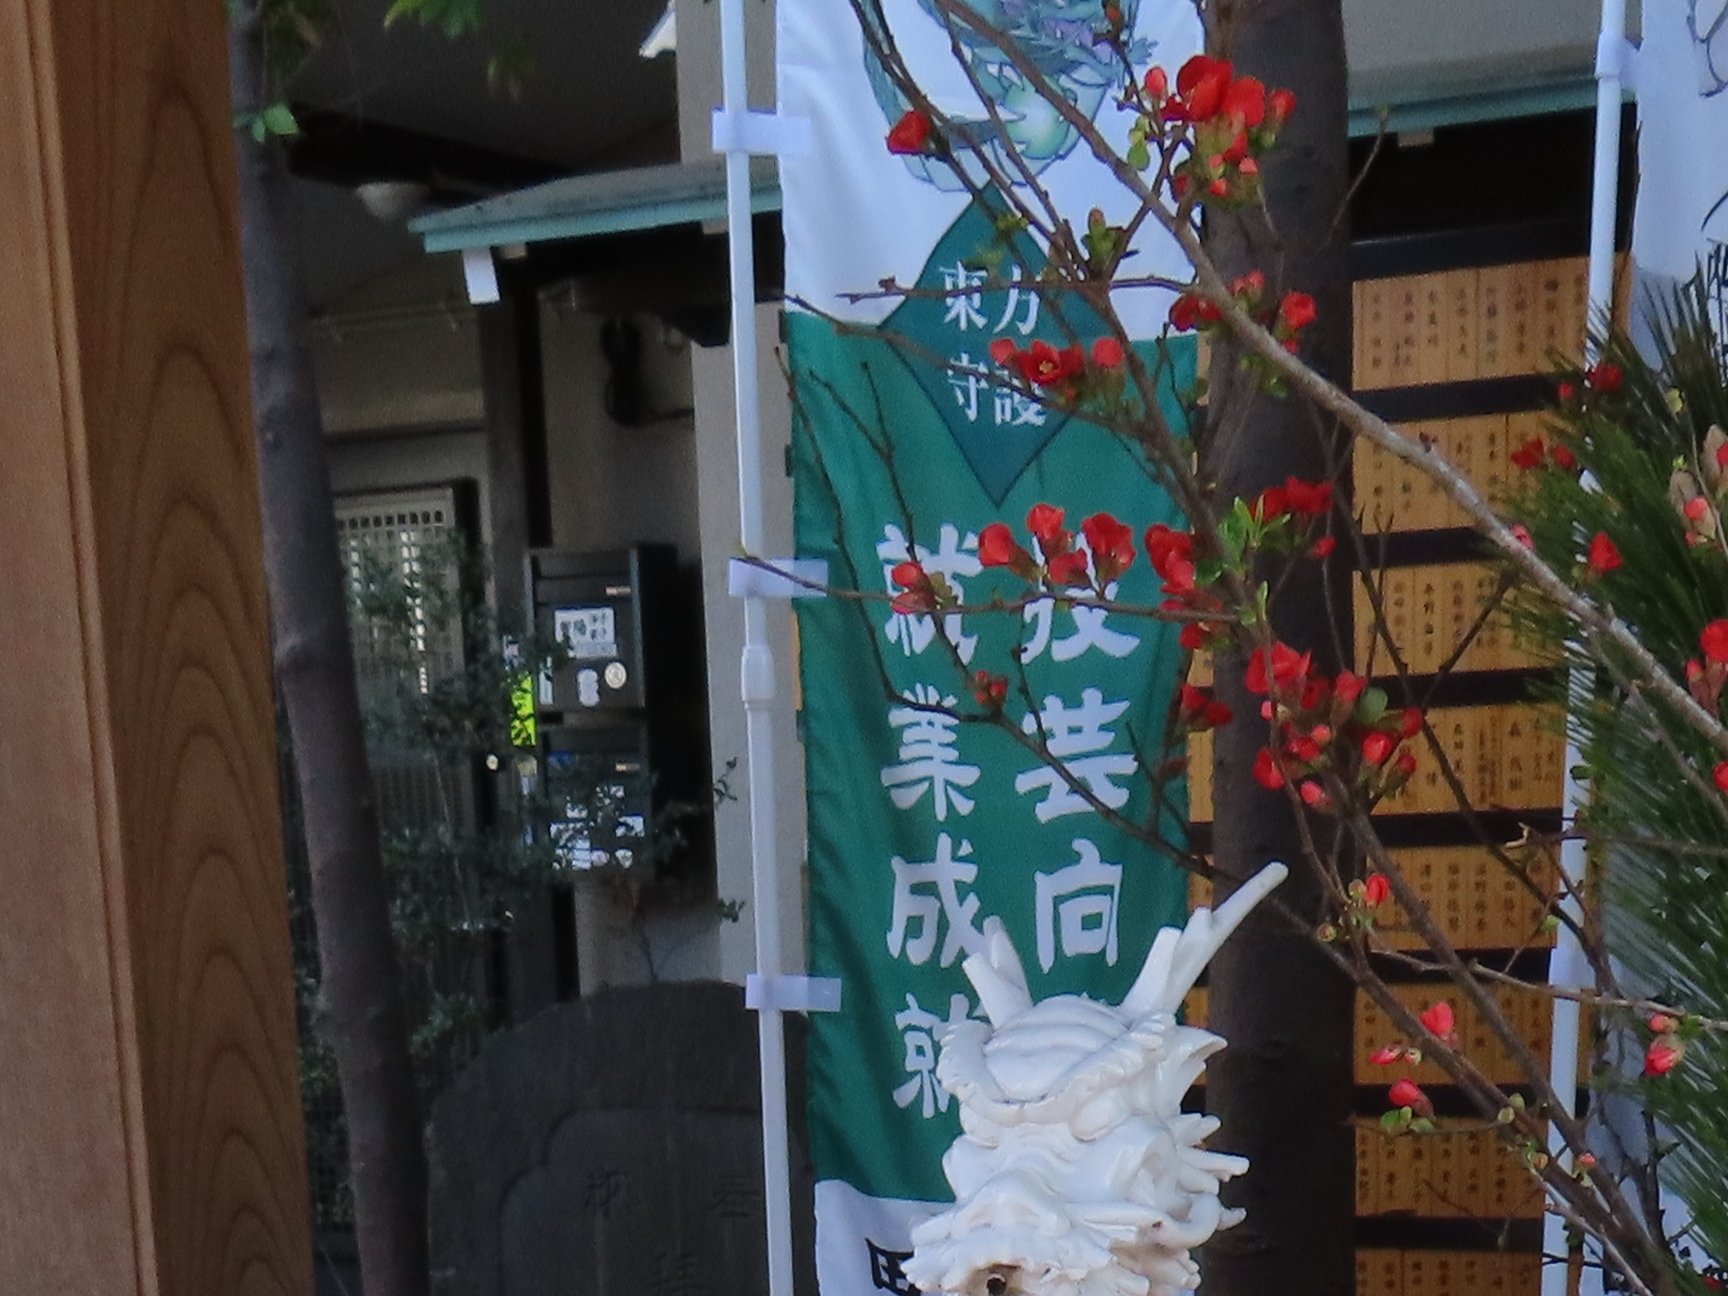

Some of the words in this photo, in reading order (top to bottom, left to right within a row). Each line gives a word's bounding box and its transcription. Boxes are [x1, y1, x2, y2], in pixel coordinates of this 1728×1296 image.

[939, 259, 1042, 336] 東方
[1014, 533, 1141, 1000] 技芸向
